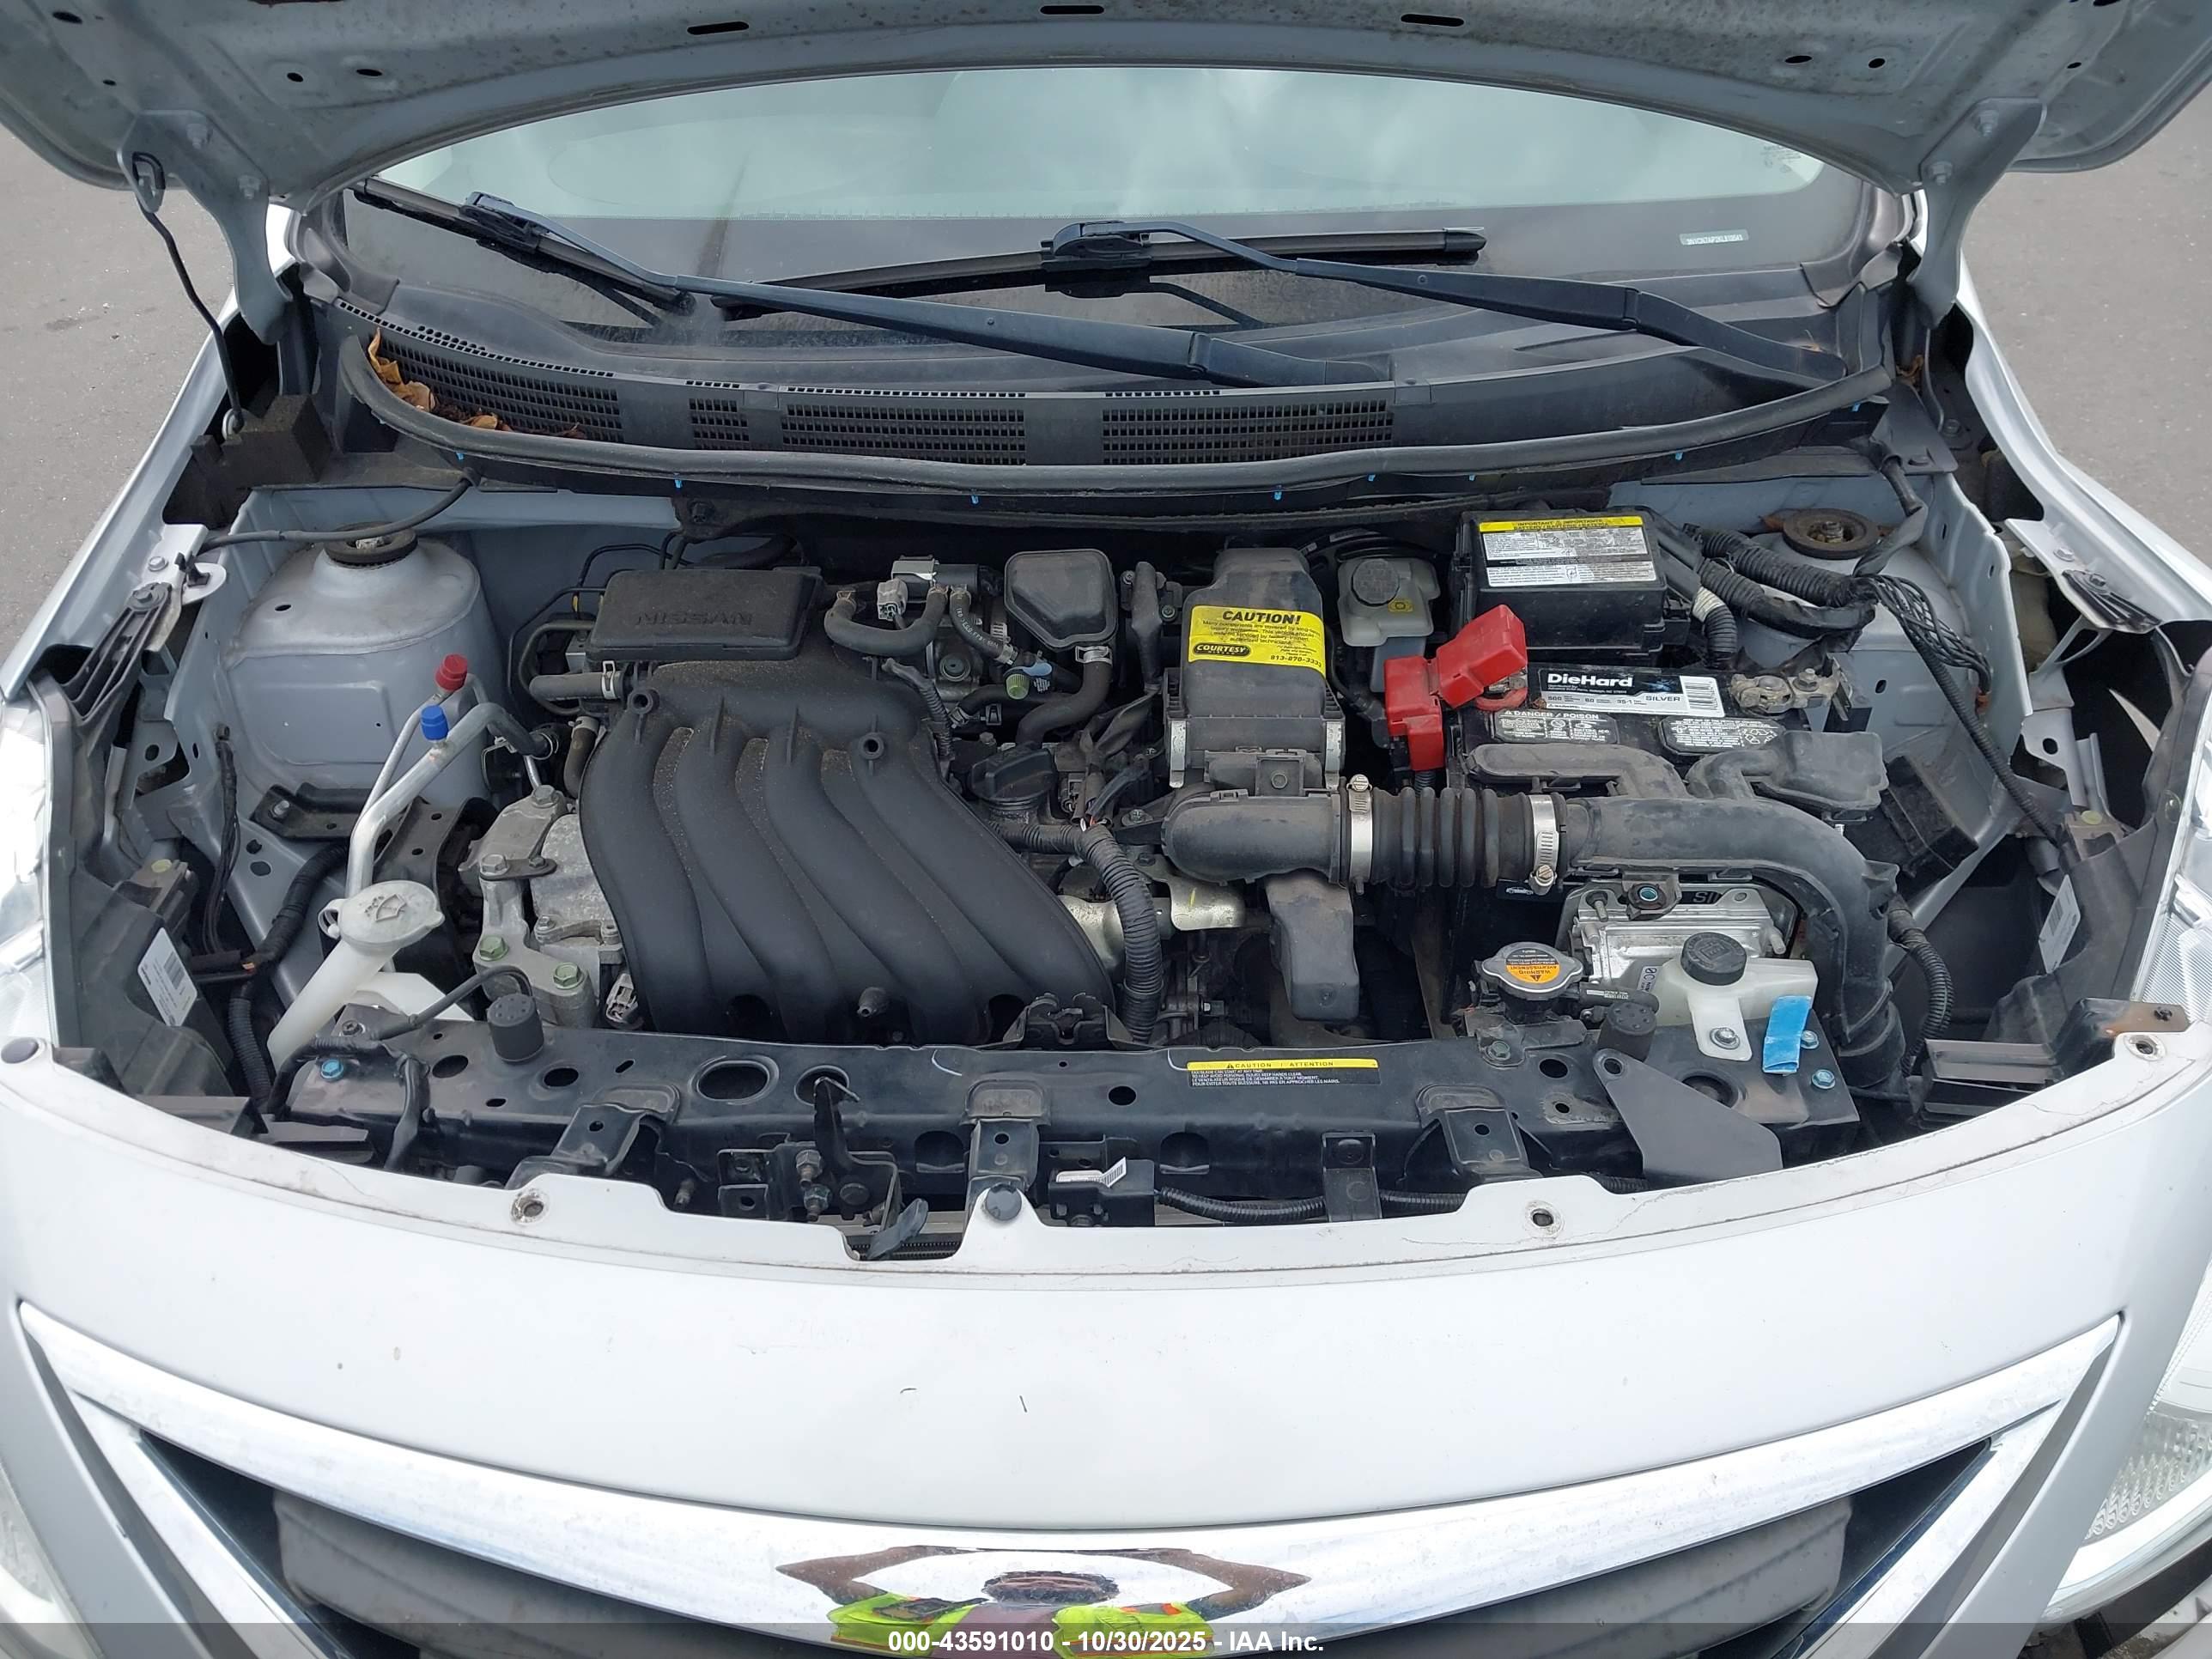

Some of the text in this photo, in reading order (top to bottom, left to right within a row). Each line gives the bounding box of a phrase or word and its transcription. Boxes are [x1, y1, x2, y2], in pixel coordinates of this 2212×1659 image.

[635, 611, 752, 626] NISSAN
[1223, 611, 1302, 625] CAUTION!
[1547, 673, 1633, 688] DieHard
